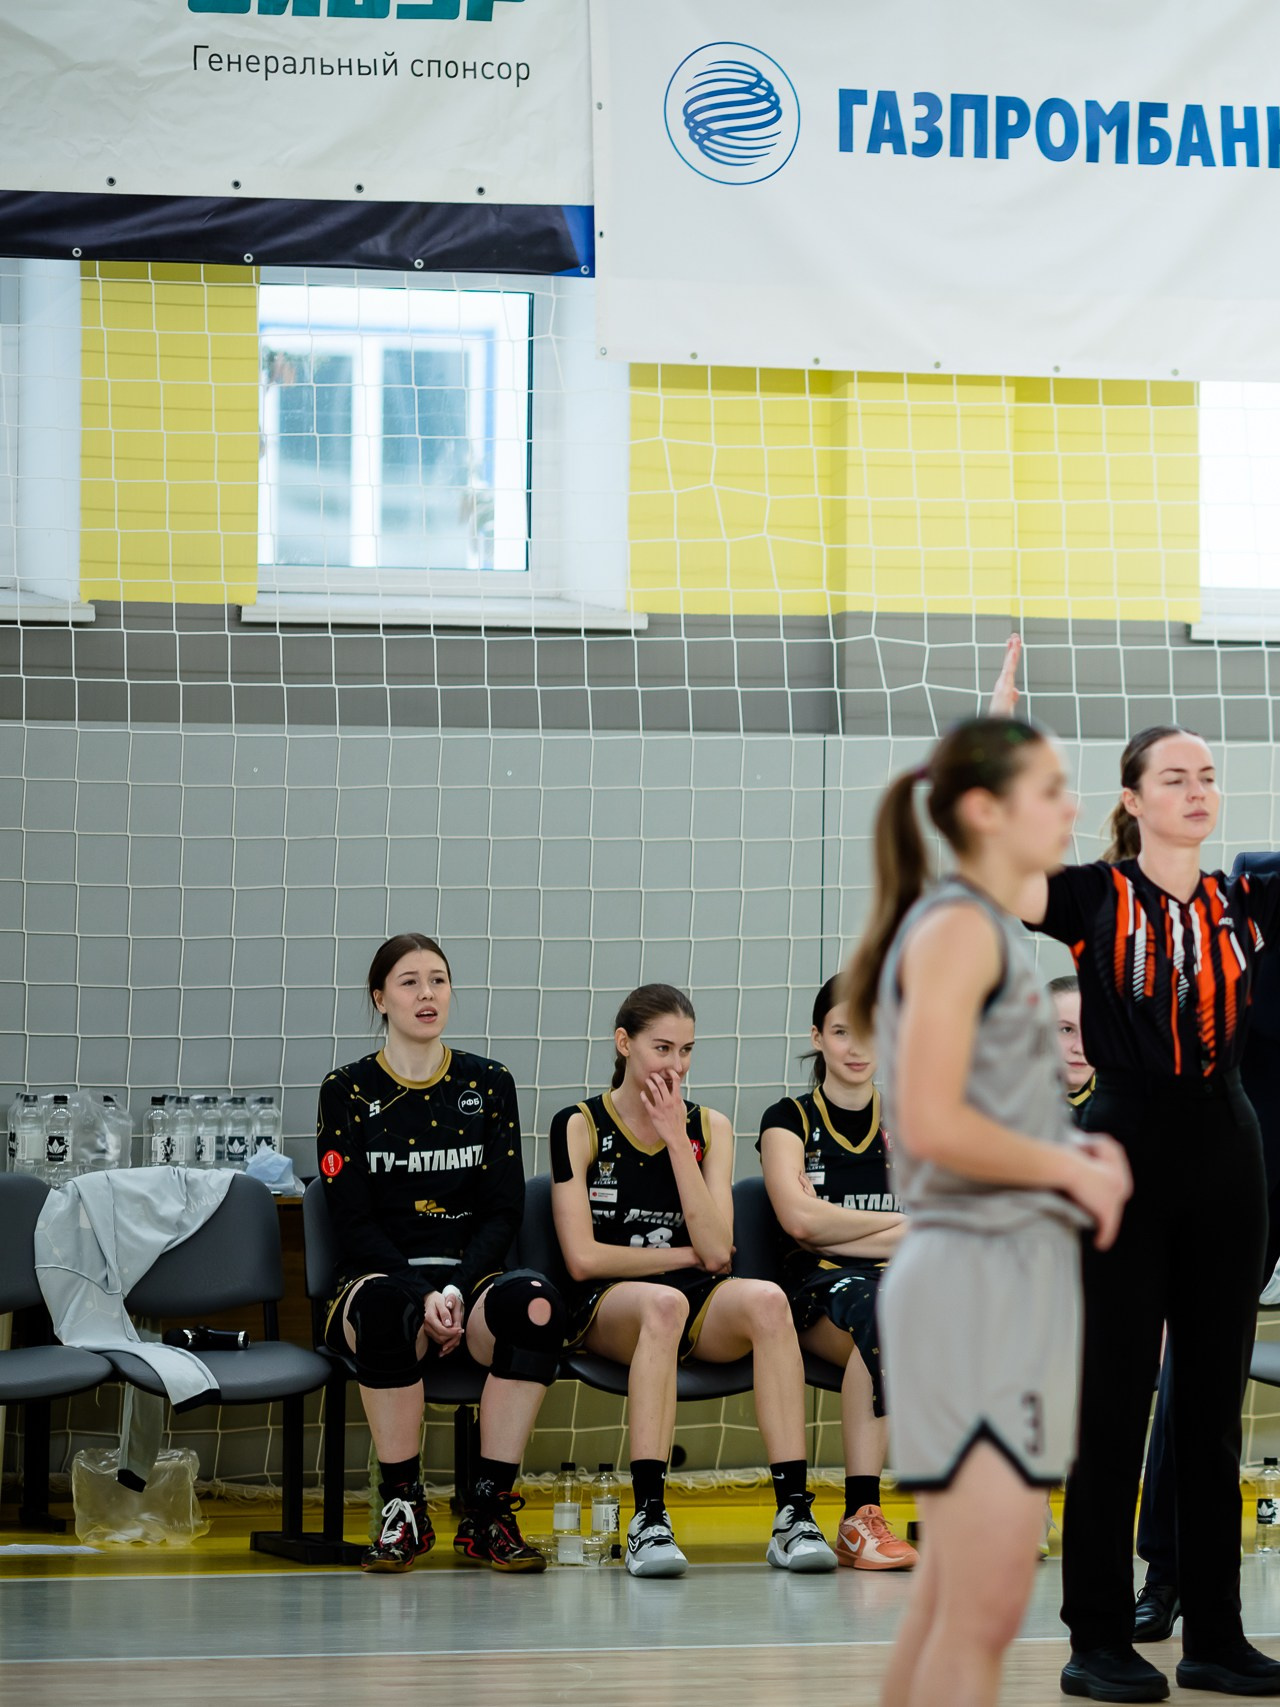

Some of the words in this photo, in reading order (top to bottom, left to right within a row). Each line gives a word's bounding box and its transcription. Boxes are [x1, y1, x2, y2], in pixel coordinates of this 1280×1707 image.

[193, 45, 399, 81] Генеральный
[410, 58, 530, 87] спонсор
[461, 1098, 480, 1107] РФБ
[366, 1144, 484, 1173] ГУ-АТЛАНТ
